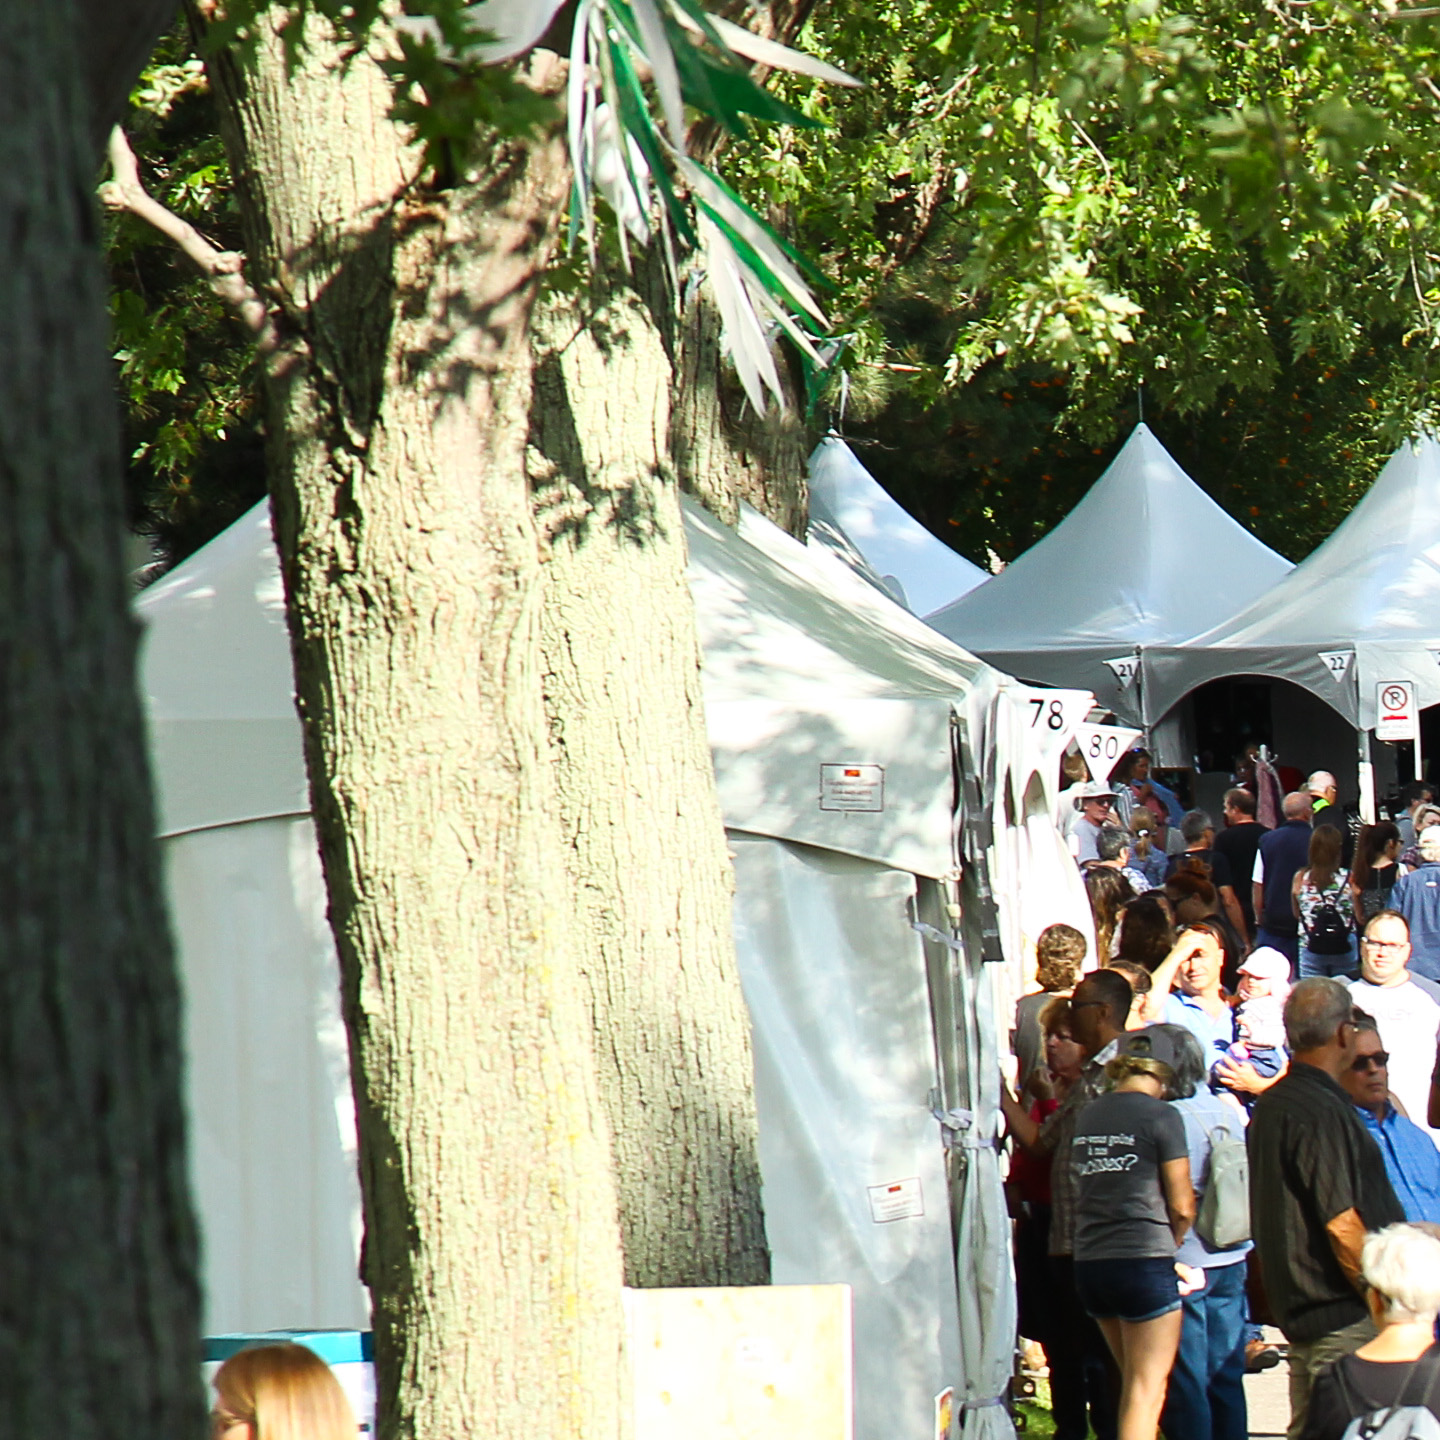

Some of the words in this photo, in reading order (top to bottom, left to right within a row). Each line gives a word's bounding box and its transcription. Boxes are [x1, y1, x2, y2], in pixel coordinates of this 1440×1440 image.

[1118, 664, 1133, 678] 21
[1330, 657, 1346, 671] 22
[1029, 698, 1064, 731] 78
[1088, 734, 1120, 760] 80
